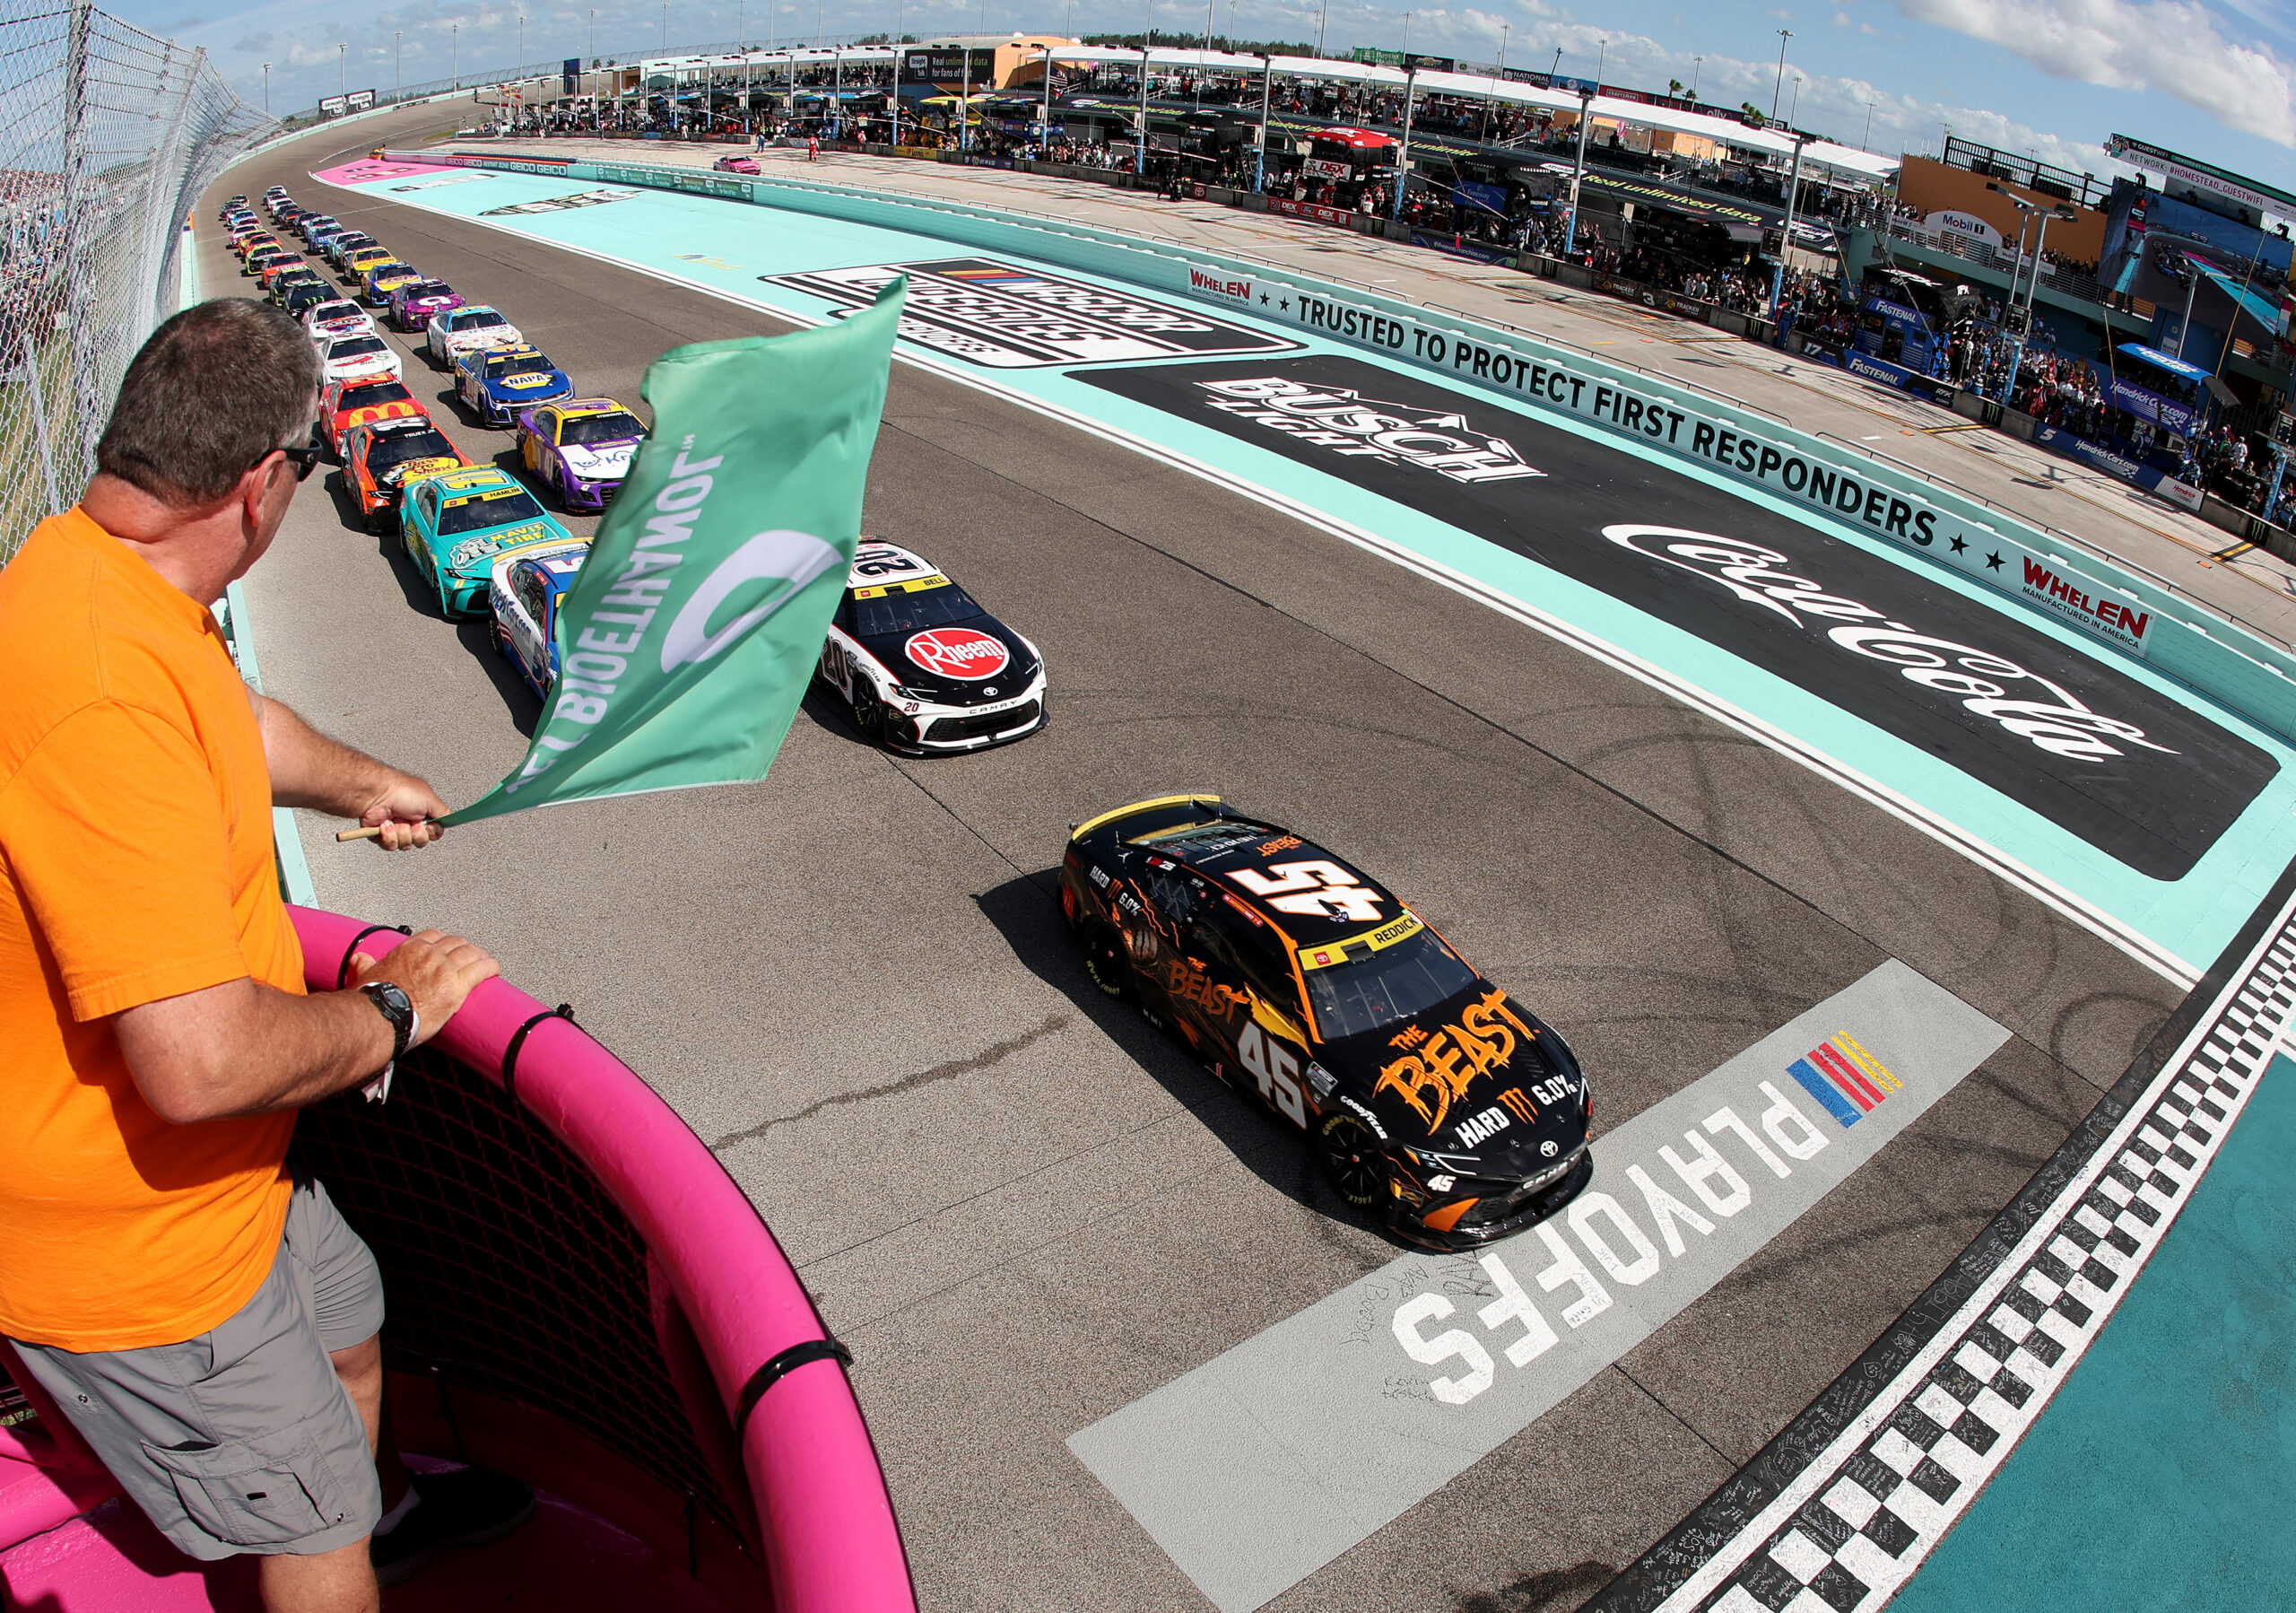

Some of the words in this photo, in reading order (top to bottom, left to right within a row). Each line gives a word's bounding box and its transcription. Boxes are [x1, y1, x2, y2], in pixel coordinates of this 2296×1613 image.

[933, 57, 944, 65] Real
[974, 57, 987, 65] data
[932, 68, 940, 77] for
[1514, 72, 1550, 83] NATIONAL
[1608, 91, 1637, 100] CRAFTSMAN
[1708, 109, 1727, 118] ally
[464, 159, 482, 167] GEICO
[510, 162, 535, 172] GEICO
[537, 164, 567, 176] GEICO
[1320, 162, 1345, 175] DEX
[2129, 153, 2168, 172] NETWORK:
[2170, 167, 2264, 206] #HOMESTEAD_GUESTWIFI
[1282, 202, 1297, 211] DEX
[1582, 175, 1624, 188] Real
[1623, 184, 1718, 210] unlimited
[1717, 206, 1762, 222] data
[1318, 209, 1335, 218] DEX
[1943, 214, 1974, 231] Mobil
[1190, 268, 1251, 300] WHELEN
[1613, 283, 1635, 294] TRACKER
[1192, 287, 1223, 301] MANUFACTURED
[1230, 296, 1249, 306] AMERICA
[1642, 292, 1656, 307] 3
[984, 281, 1214, 333] NASCAR
[1675, 301, 1700, 314] TRACKER
[1875, 301, 1917, 323] FASTENAL
[1804, 342, 1822, 355] 17
[509, 374, 546, 386] NAPA
[1849, 358, 1900, 387] FASTENAL
[1193, 376, 1548, 484] BUSCH
[1205, 395, 1398, 466] LIGHT
[1299, 296, 1405, 349] TRUSTED
[1413, 328, 1446, 362] TO
[1455, 343, 1586, 408] PROTECT
[1593, 386, 1685, 443] FIRST
[1692, 421, 1937, 546] RESPONDERS
[2039, 428, 2057, 440] 5
[407, 458, 439, 467] Bass
[413, 463, 434, 471] Pro
[413, 466, 453, 476] Shops
[490, 487, 520, 499] HAMLIN
[490, 523, 546, 543] MAVIS
[504, 532, 546, 545] TIRE
[923, 579, 945, 587] BELL
[2022, 555, 2149, 640] WHELEN
[2022, 586, 2090, 623] MANUFACTURED
[2091, 619, 2100, 630] IN
[2101, 624, 2139, 649] AMERICA
[910, 631, 1004, 673] Rheem
[859, 661, 881, 683] GOODYEAR
[904, 702, 919, 713] 20
[970, 700, 1018, 714] CAMRY
[1257, 835, 1302, 857] BEAST
[1089, 866, 1110, 889] HARD
[1224, 860, 1384, 921] 45
[1118, 893, 1141, 917] 6.0%
[1374, 917, 1418, 945] REDDICK
[1187, 956, 1207, 972] THE
[1167, 959, 1251, 1021] BEAST
[1387, 1024, 1429, 1051] THE
[1372, 989, 1538, 1136] BEAST
[1238, 1020, 1308, 1130] 45
[1531, 1074, 1578, 1106] 6.0%
[1340, 1095, 1388, 1140] GOODYEAR
[1455, 1106, 1510, 1149] HARD
[1427, 1174, 1457, 1192] 45
[1391, 1080, 1830, 1406] PLAYOFFS
